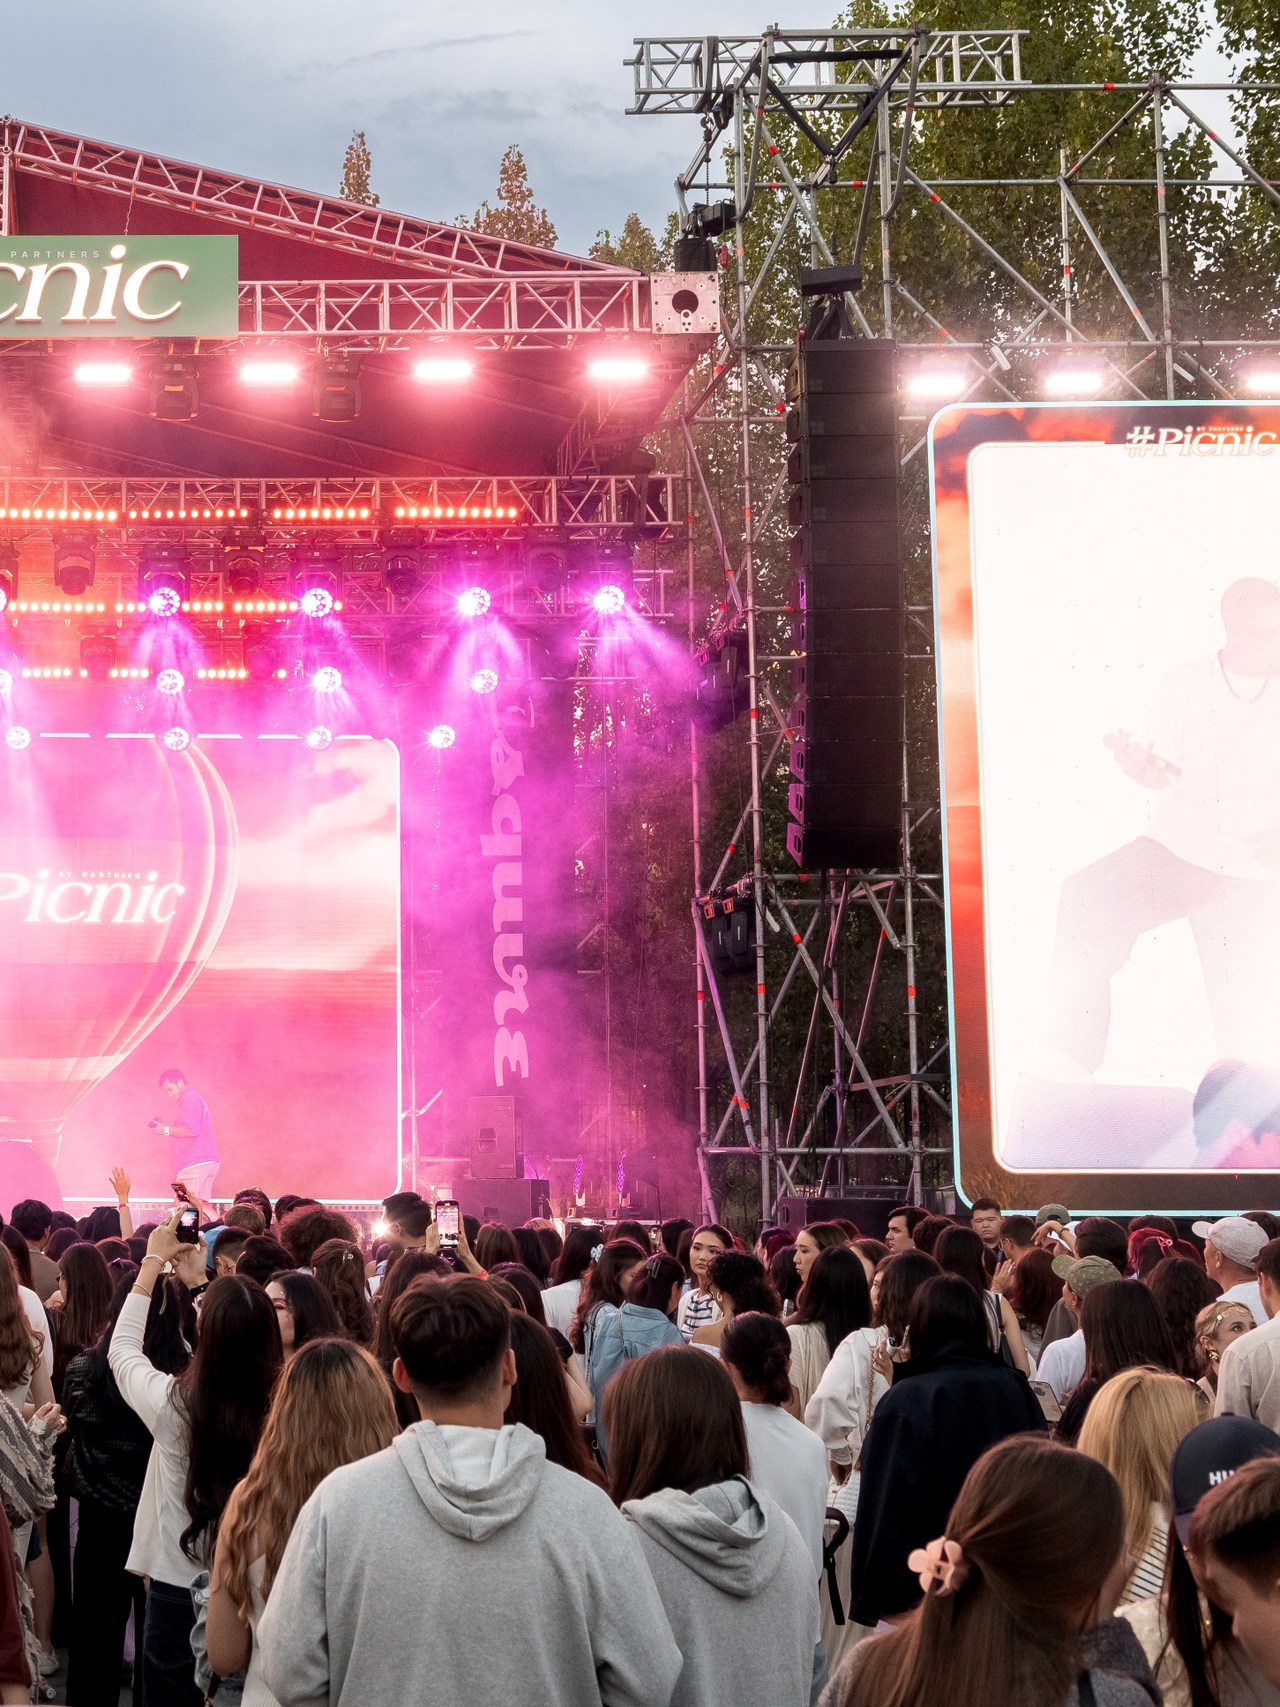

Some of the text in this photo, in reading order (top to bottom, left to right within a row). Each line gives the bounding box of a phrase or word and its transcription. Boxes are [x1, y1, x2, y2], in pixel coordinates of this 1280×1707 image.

[10, 250, 101, 259] PARTNERS
[1125, 426, 1277, 457] #Picnic
[58, 871, 142, 879] BY PARTNERS
